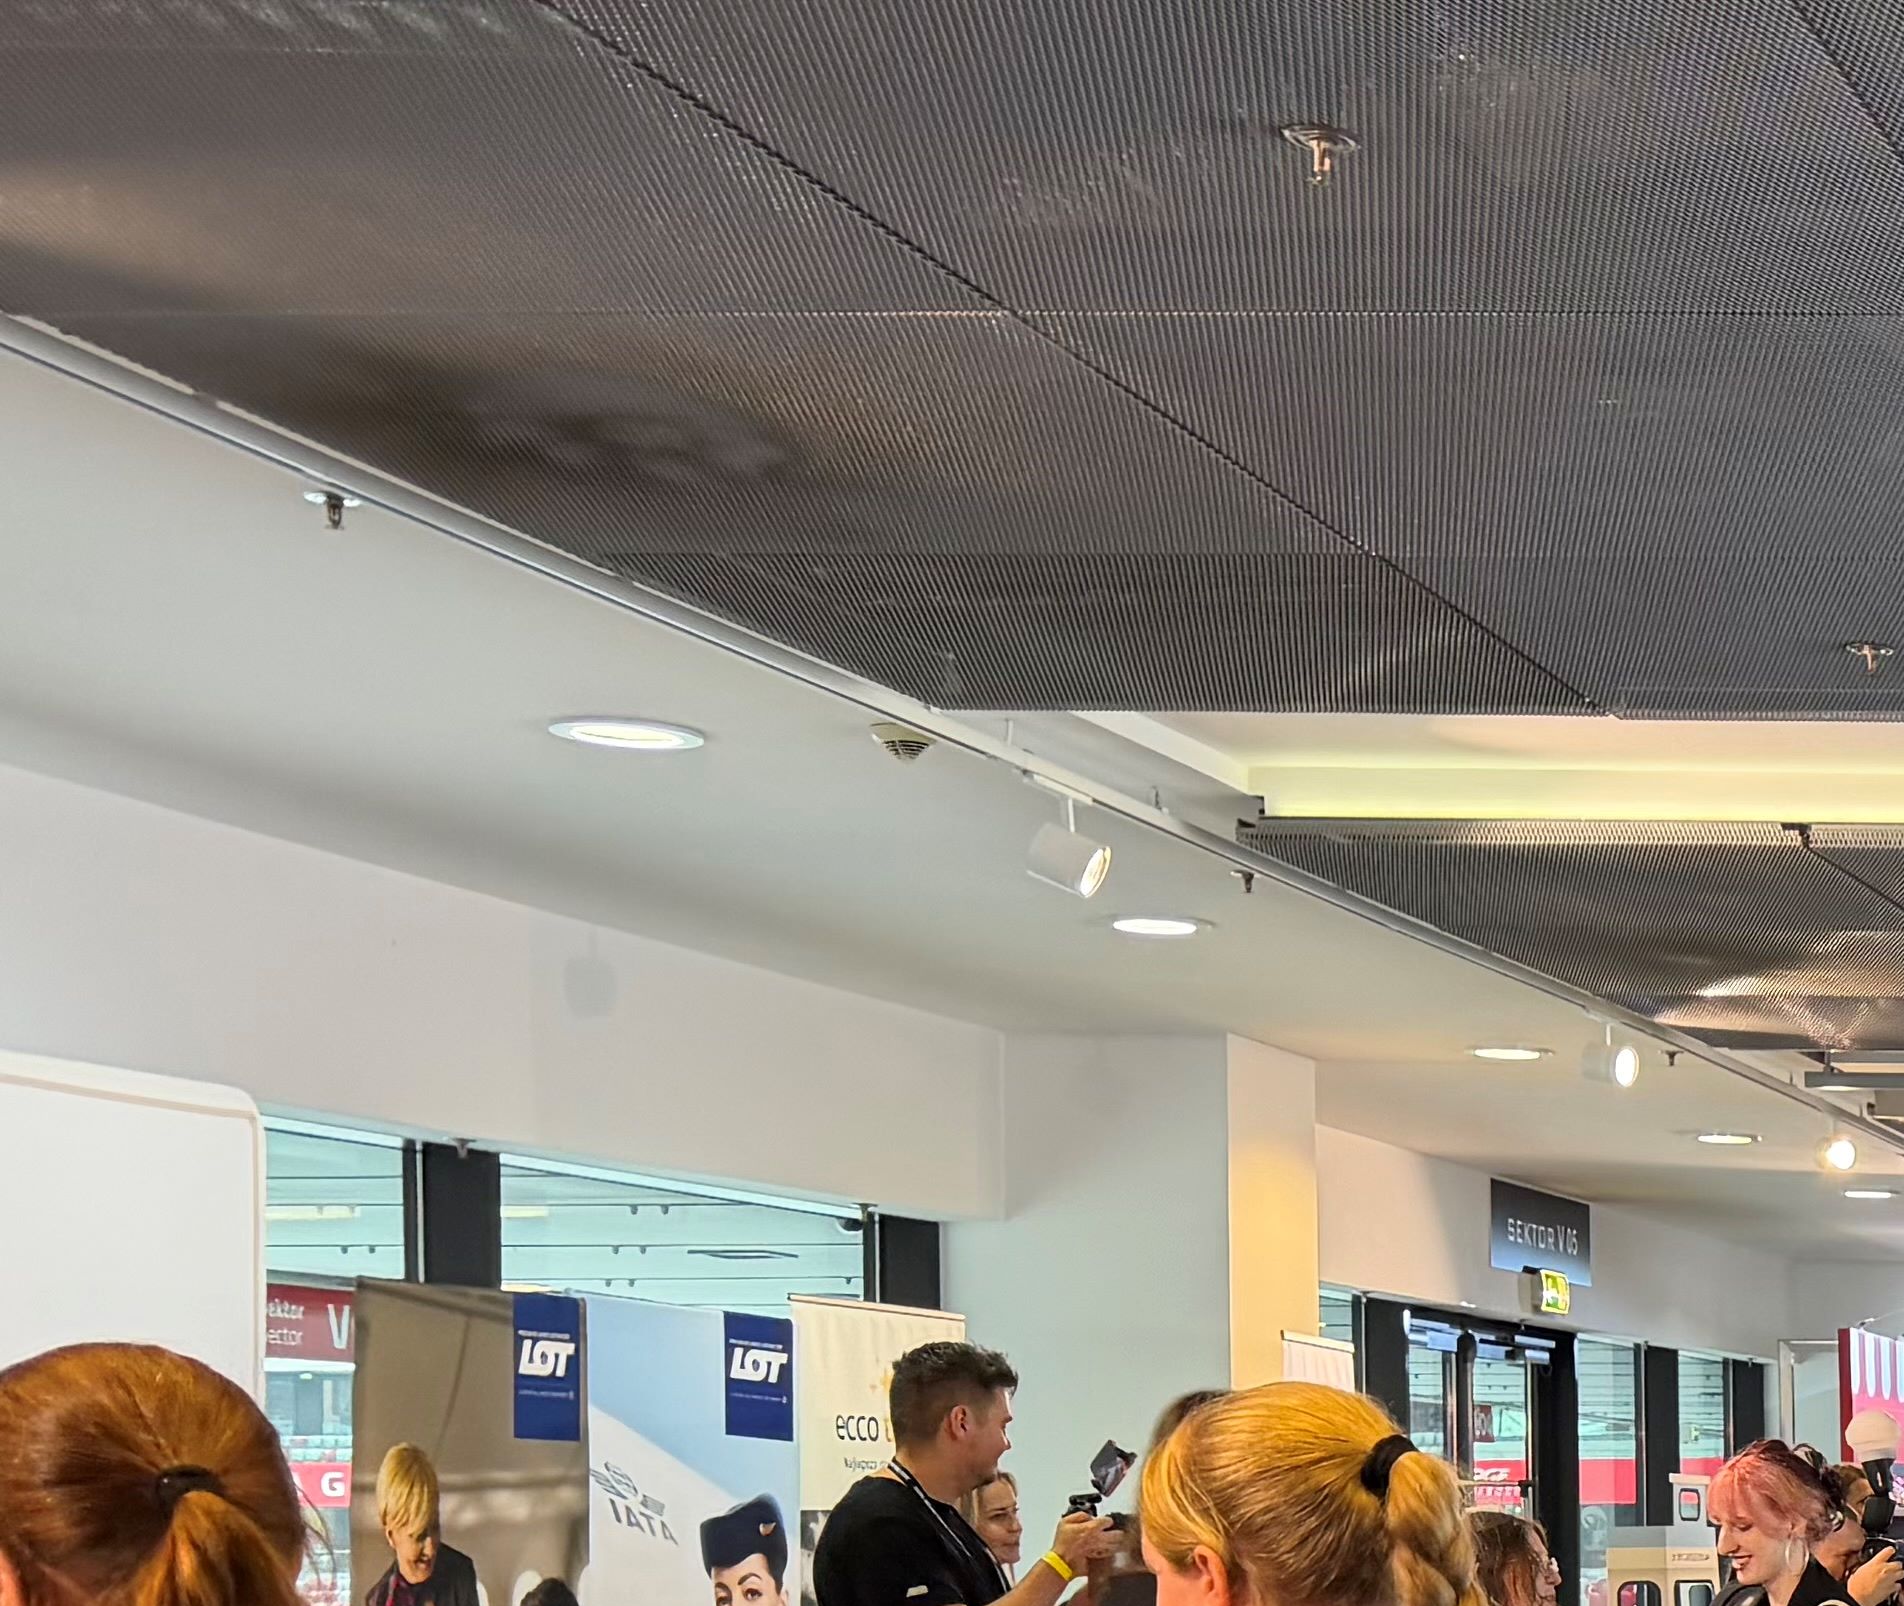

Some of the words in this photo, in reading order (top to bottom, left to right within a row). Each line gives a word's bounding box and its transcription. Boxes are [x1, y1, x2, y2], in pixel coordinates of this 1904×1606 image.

[1507, 1217, 1555, 1252] SEKTOR
[518, 1339, 576, 1378] LOT
[730, 1347, 788, 1384] LOT
[836, 1414, 879, 1442] ecco
[608, 1497, 679, 1546] IATA
